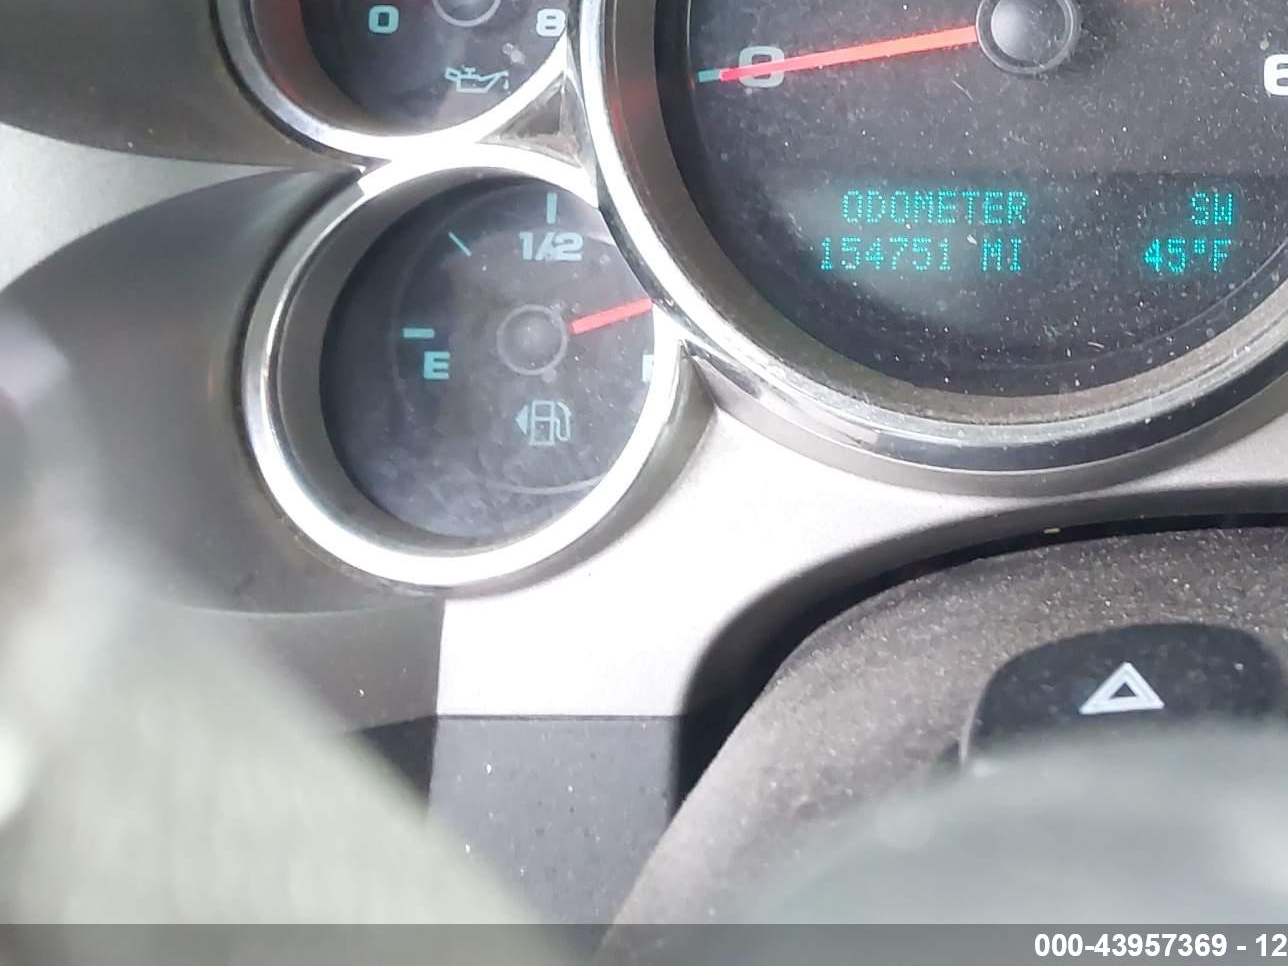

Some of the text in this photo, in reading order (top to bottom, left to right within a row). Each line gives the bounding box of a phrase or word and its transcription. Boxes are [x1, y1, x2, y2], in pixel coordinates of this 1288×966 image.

[368, 4, 399, 34] 0
[738, 45, 785, 88] 0
[841, 190, 1029, 225] ODOMETER
[1190, 192, 1234, 226] SW
[519, 232, 584, 261] 1/2
[820, 237, 1023, 273] 154751 MI
[423, 351, 450, 380] E
